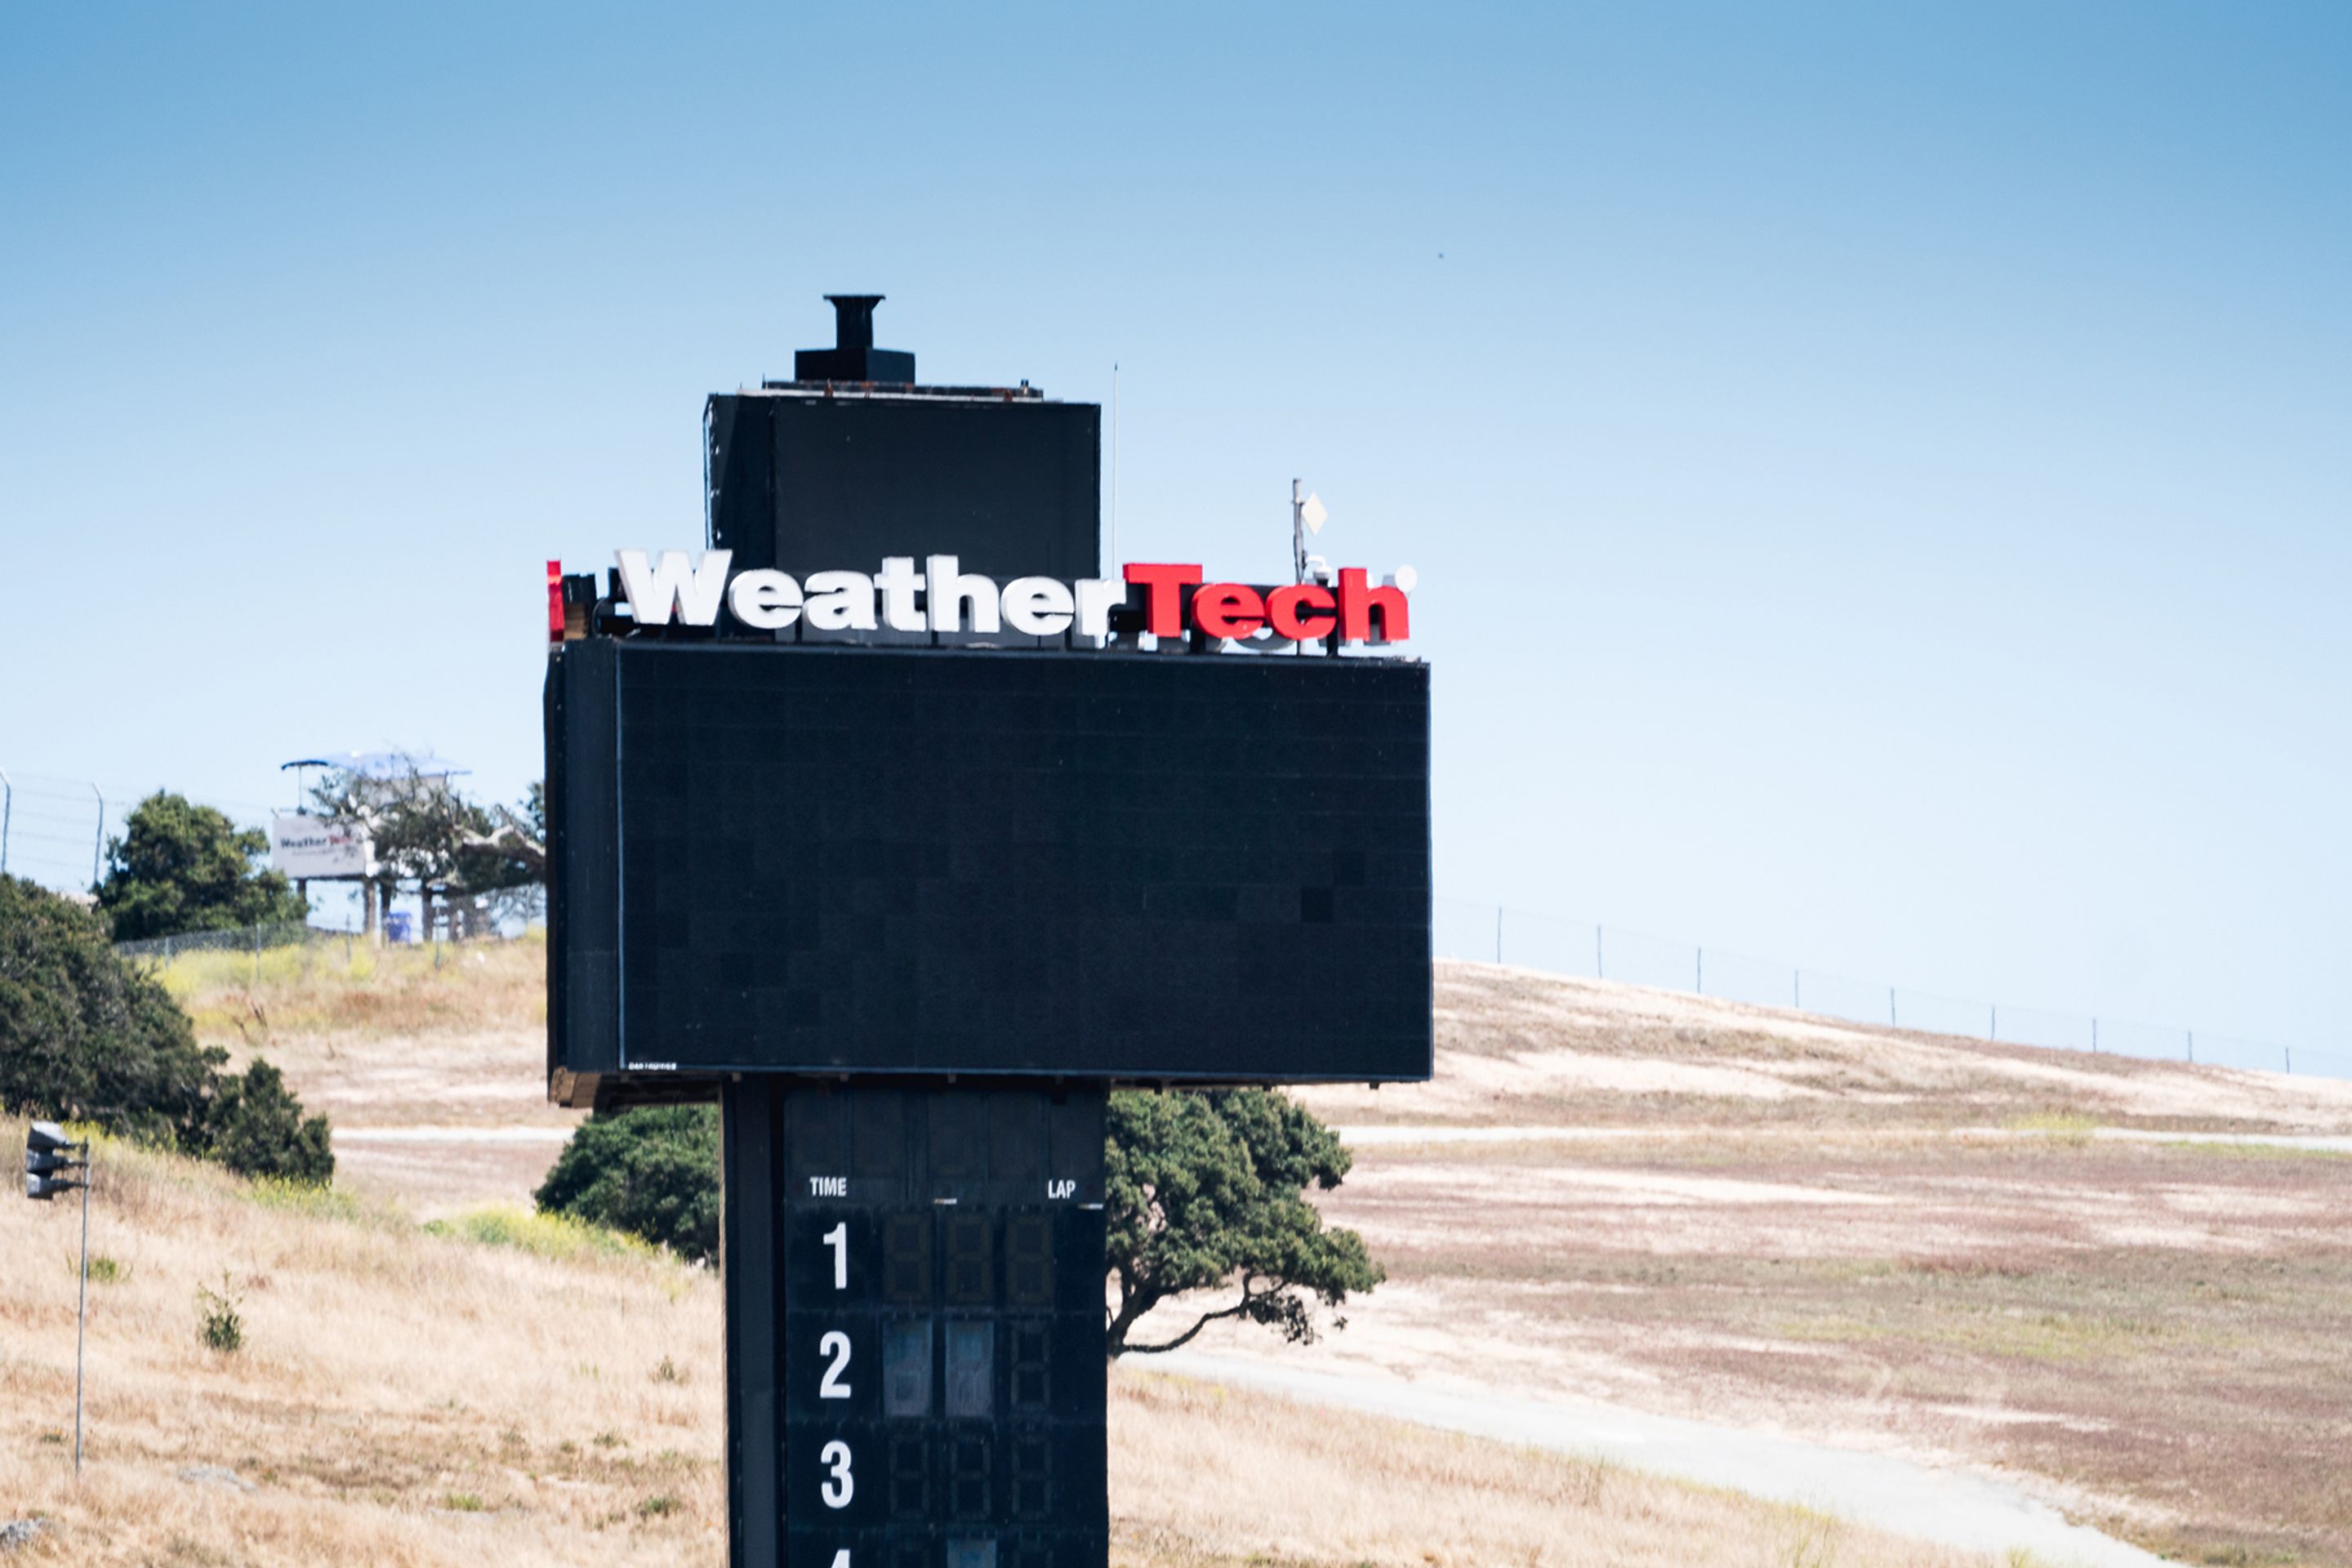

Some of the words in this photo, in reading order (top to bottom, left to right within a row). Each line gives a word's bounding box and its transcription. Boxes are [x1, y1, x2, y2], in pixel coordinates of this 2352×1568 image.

[614, 549, 1410, 642] WeatherTech
[809, 1176, 847, 1196] TIME
[1048, 1179, 1076, 1200] LAP
[822, 1222, 847, 1290] 1
[819, 1330, 851, 1399] 2
[820, 1440, 854, 1508] 3
